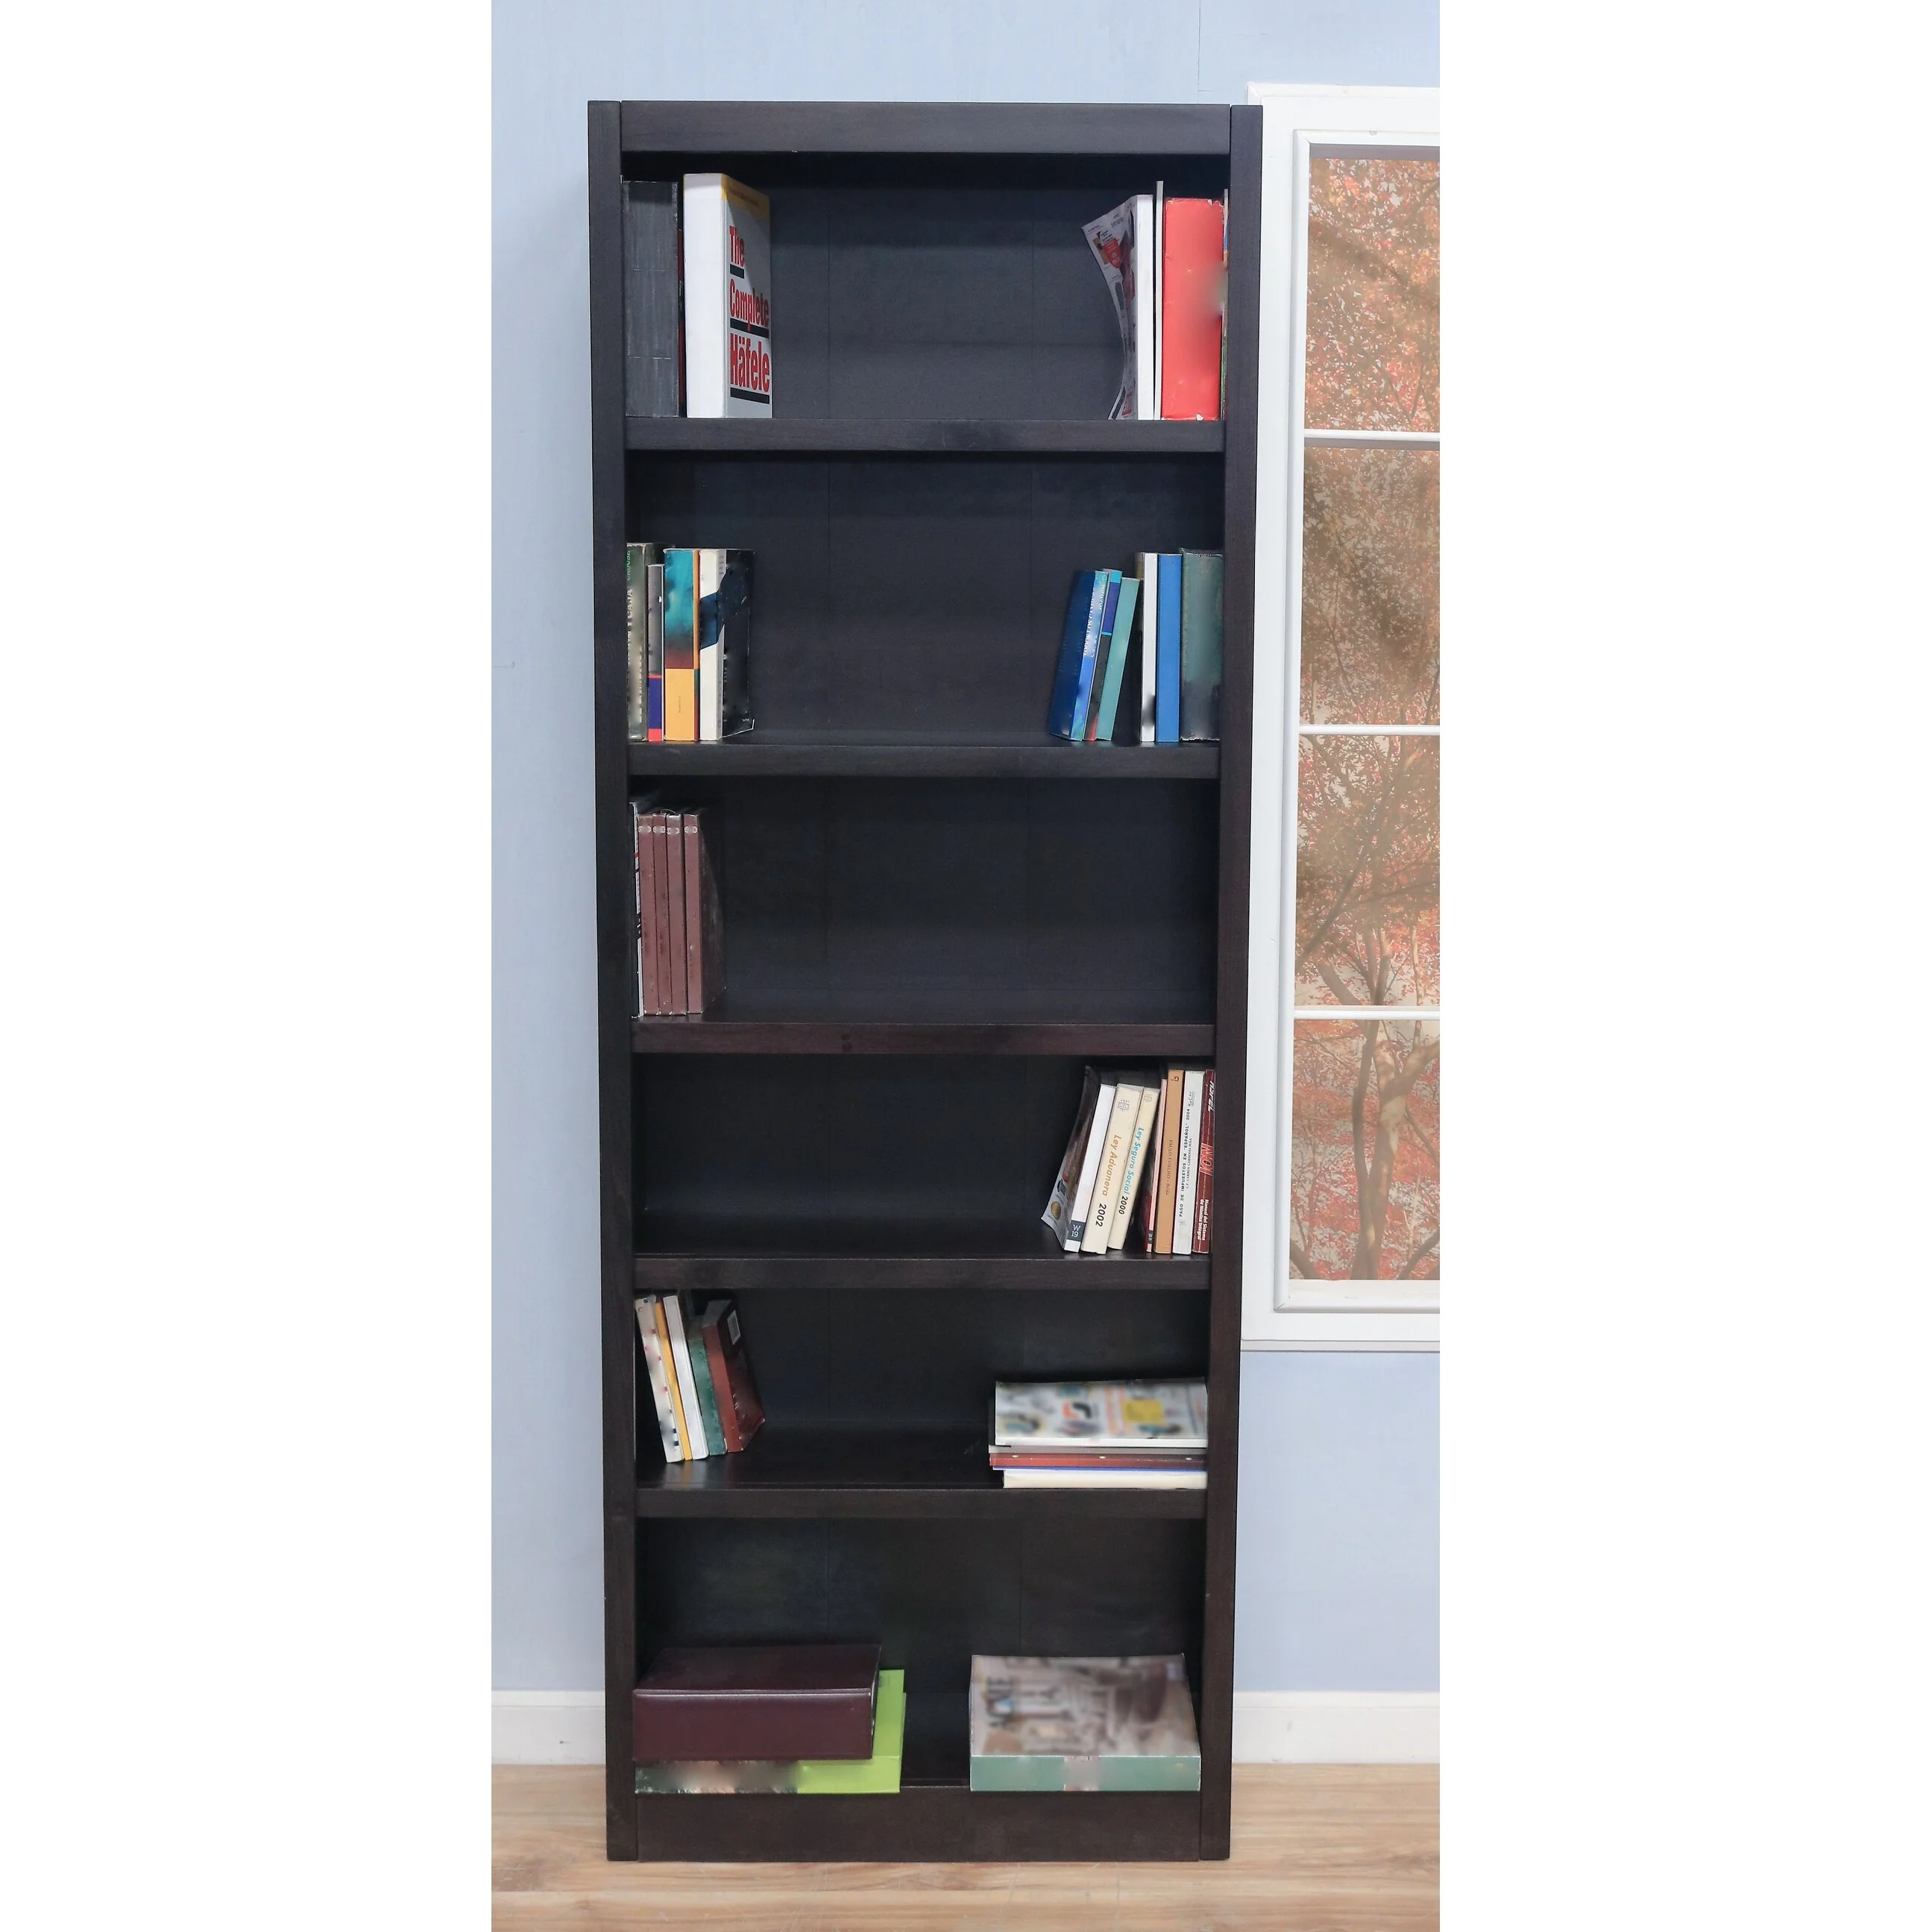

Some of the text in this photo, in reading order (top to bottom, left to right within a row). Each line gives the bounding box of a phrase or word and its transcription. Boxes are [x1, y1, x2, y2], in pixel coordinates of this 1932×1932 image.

[729, 225, 745, 267] The
[729, 278, 769, 333] Complete
[729, 333, 770, 393] Häfele
[1095, 1134, 1121, 1227] Ley Aduanera 2002
[1118, 1127, 1145, 1215] Ley Seguro Social 2000
